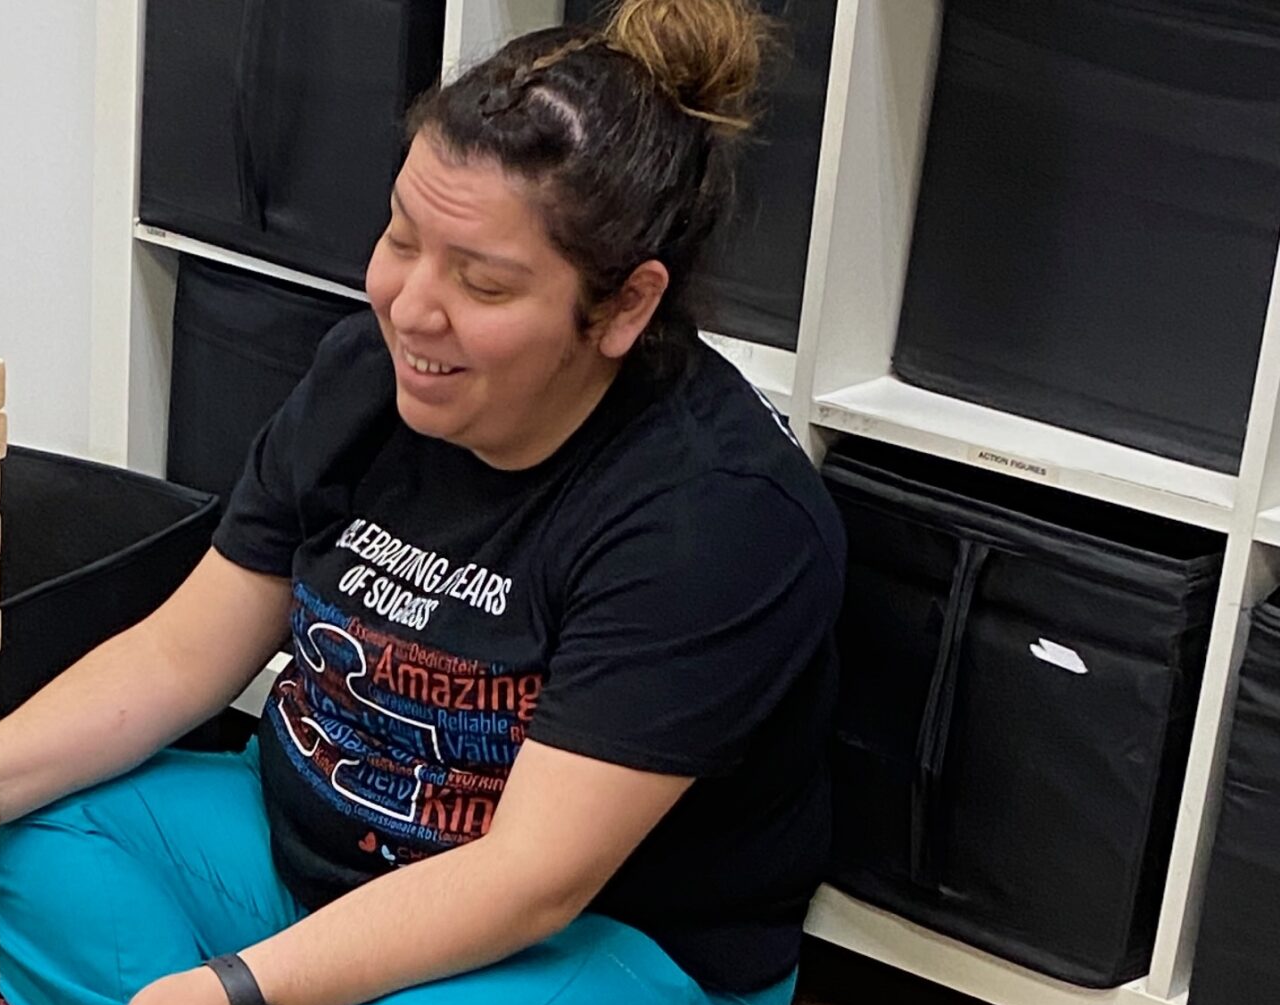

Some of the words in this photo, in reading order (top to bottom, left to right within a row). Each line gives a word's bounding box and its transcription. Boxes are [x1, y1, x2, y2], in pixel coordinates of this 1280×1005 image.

[978, 451, 1008, 466] ACTION
[1010, 459, 1047, 476] FIGURES
[338, 564, 376, 596] OF
[373, 643, 542, 720] Amazing
[438, 709, 508, 734] Reliable
[445, 733, 520, 764] Valu
